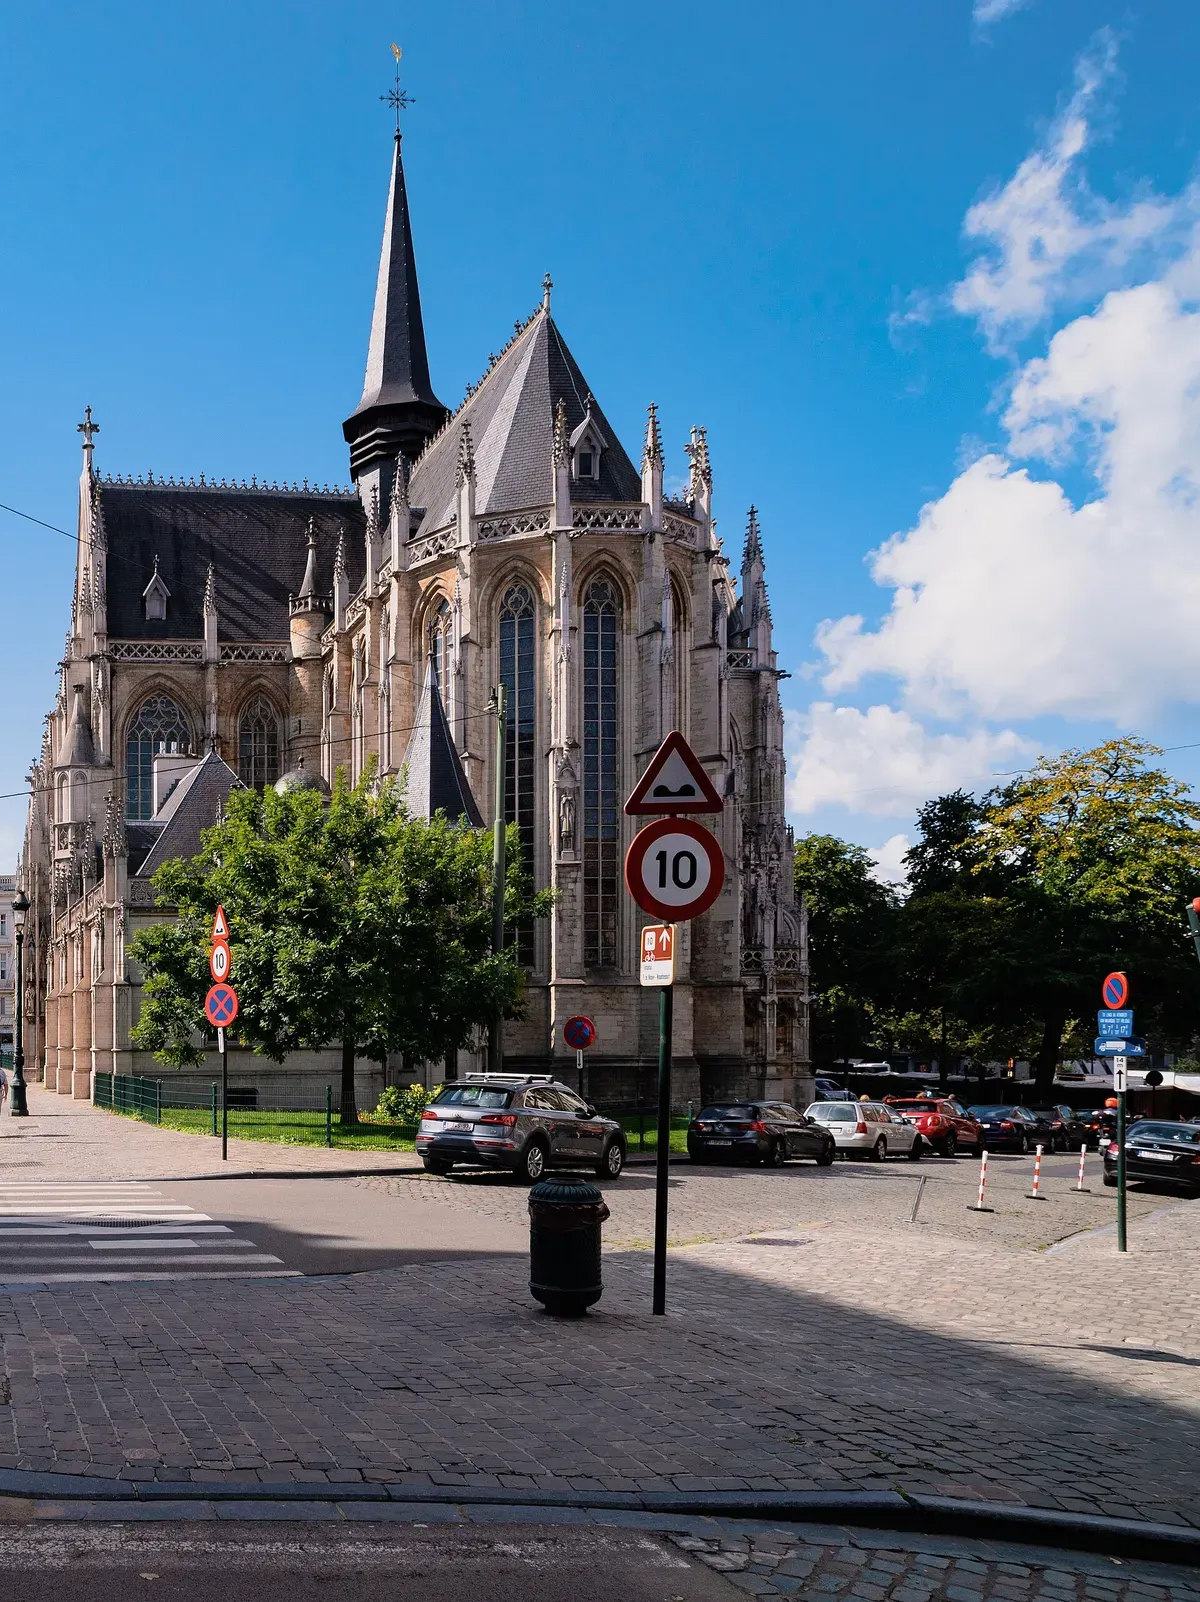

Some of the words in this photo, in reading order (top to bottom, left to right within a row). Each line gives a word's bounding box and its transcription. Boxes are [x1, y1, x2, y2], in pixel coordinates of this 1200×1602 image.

[656, 851, 697, 889] 10
[648, 937, 653, 945] 10
[215, 953, 224, 969] 10
